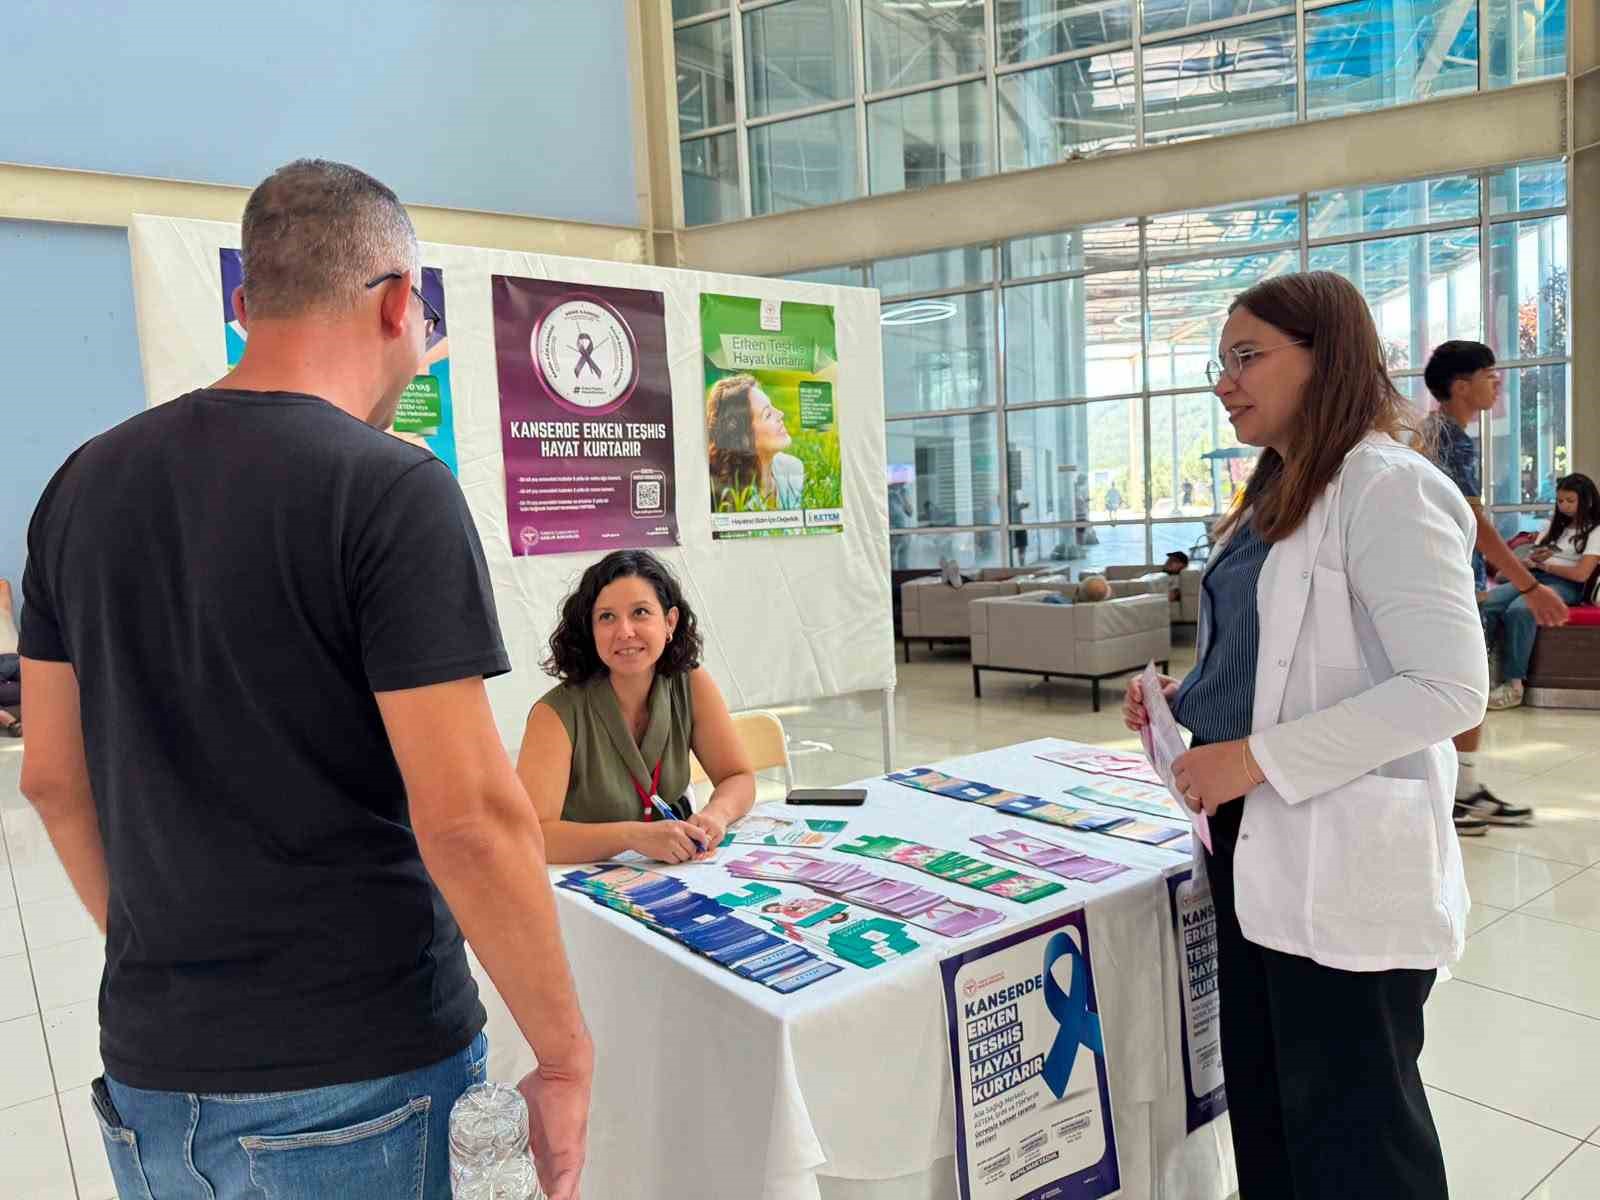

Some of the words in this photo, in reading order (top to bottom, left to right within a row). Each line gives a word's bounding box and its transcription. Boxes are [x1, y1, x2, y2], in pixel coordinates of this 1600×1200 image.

[510, 421, 581, 439] KANSERDE
[583, 423, 623, 439] ERKEN
[625, 423, 667, 440] TEŞHİS
[540, 440, 580, 457] HAYAT
[583, 440, 642, 457] KURTARIR
[1182, 905, 1215, 927] KANS
[1189, 959, 1218, 982] HAYA
[965, 974, 1043, 1019] KANSERDE
[1191, 976, 1218, 1000] KURT
[967, 1005, 1016, 1040] ERKEN
[971, 1046, 1020, 1083] HAYAT
[972, 1056, 1043, 1105] KURTARIR
